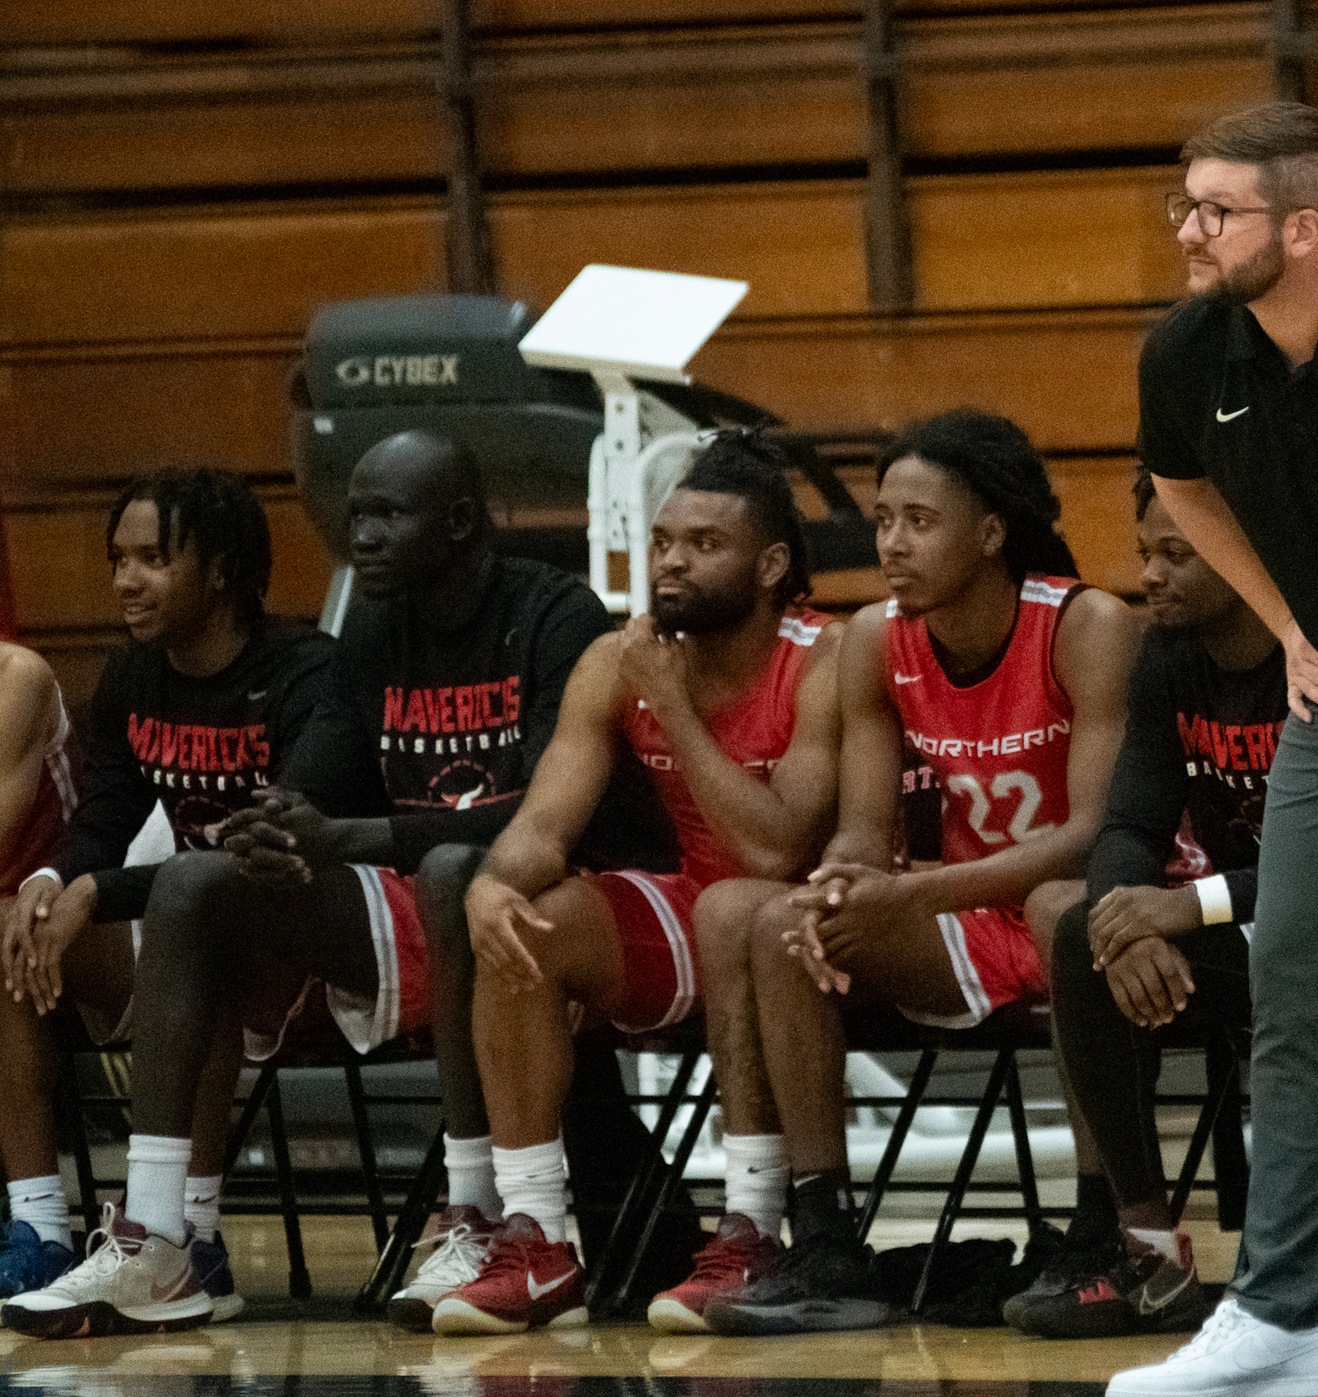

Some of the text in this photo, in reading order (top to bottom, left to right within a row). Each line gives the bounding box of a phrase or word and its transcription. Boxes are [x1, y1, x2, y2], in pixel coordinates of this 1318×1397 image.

[374, 355, 458, 387] CYBEX
[905, 718, 1071, 759] NORTHERN
[948, 770, 1055, 844] 22
